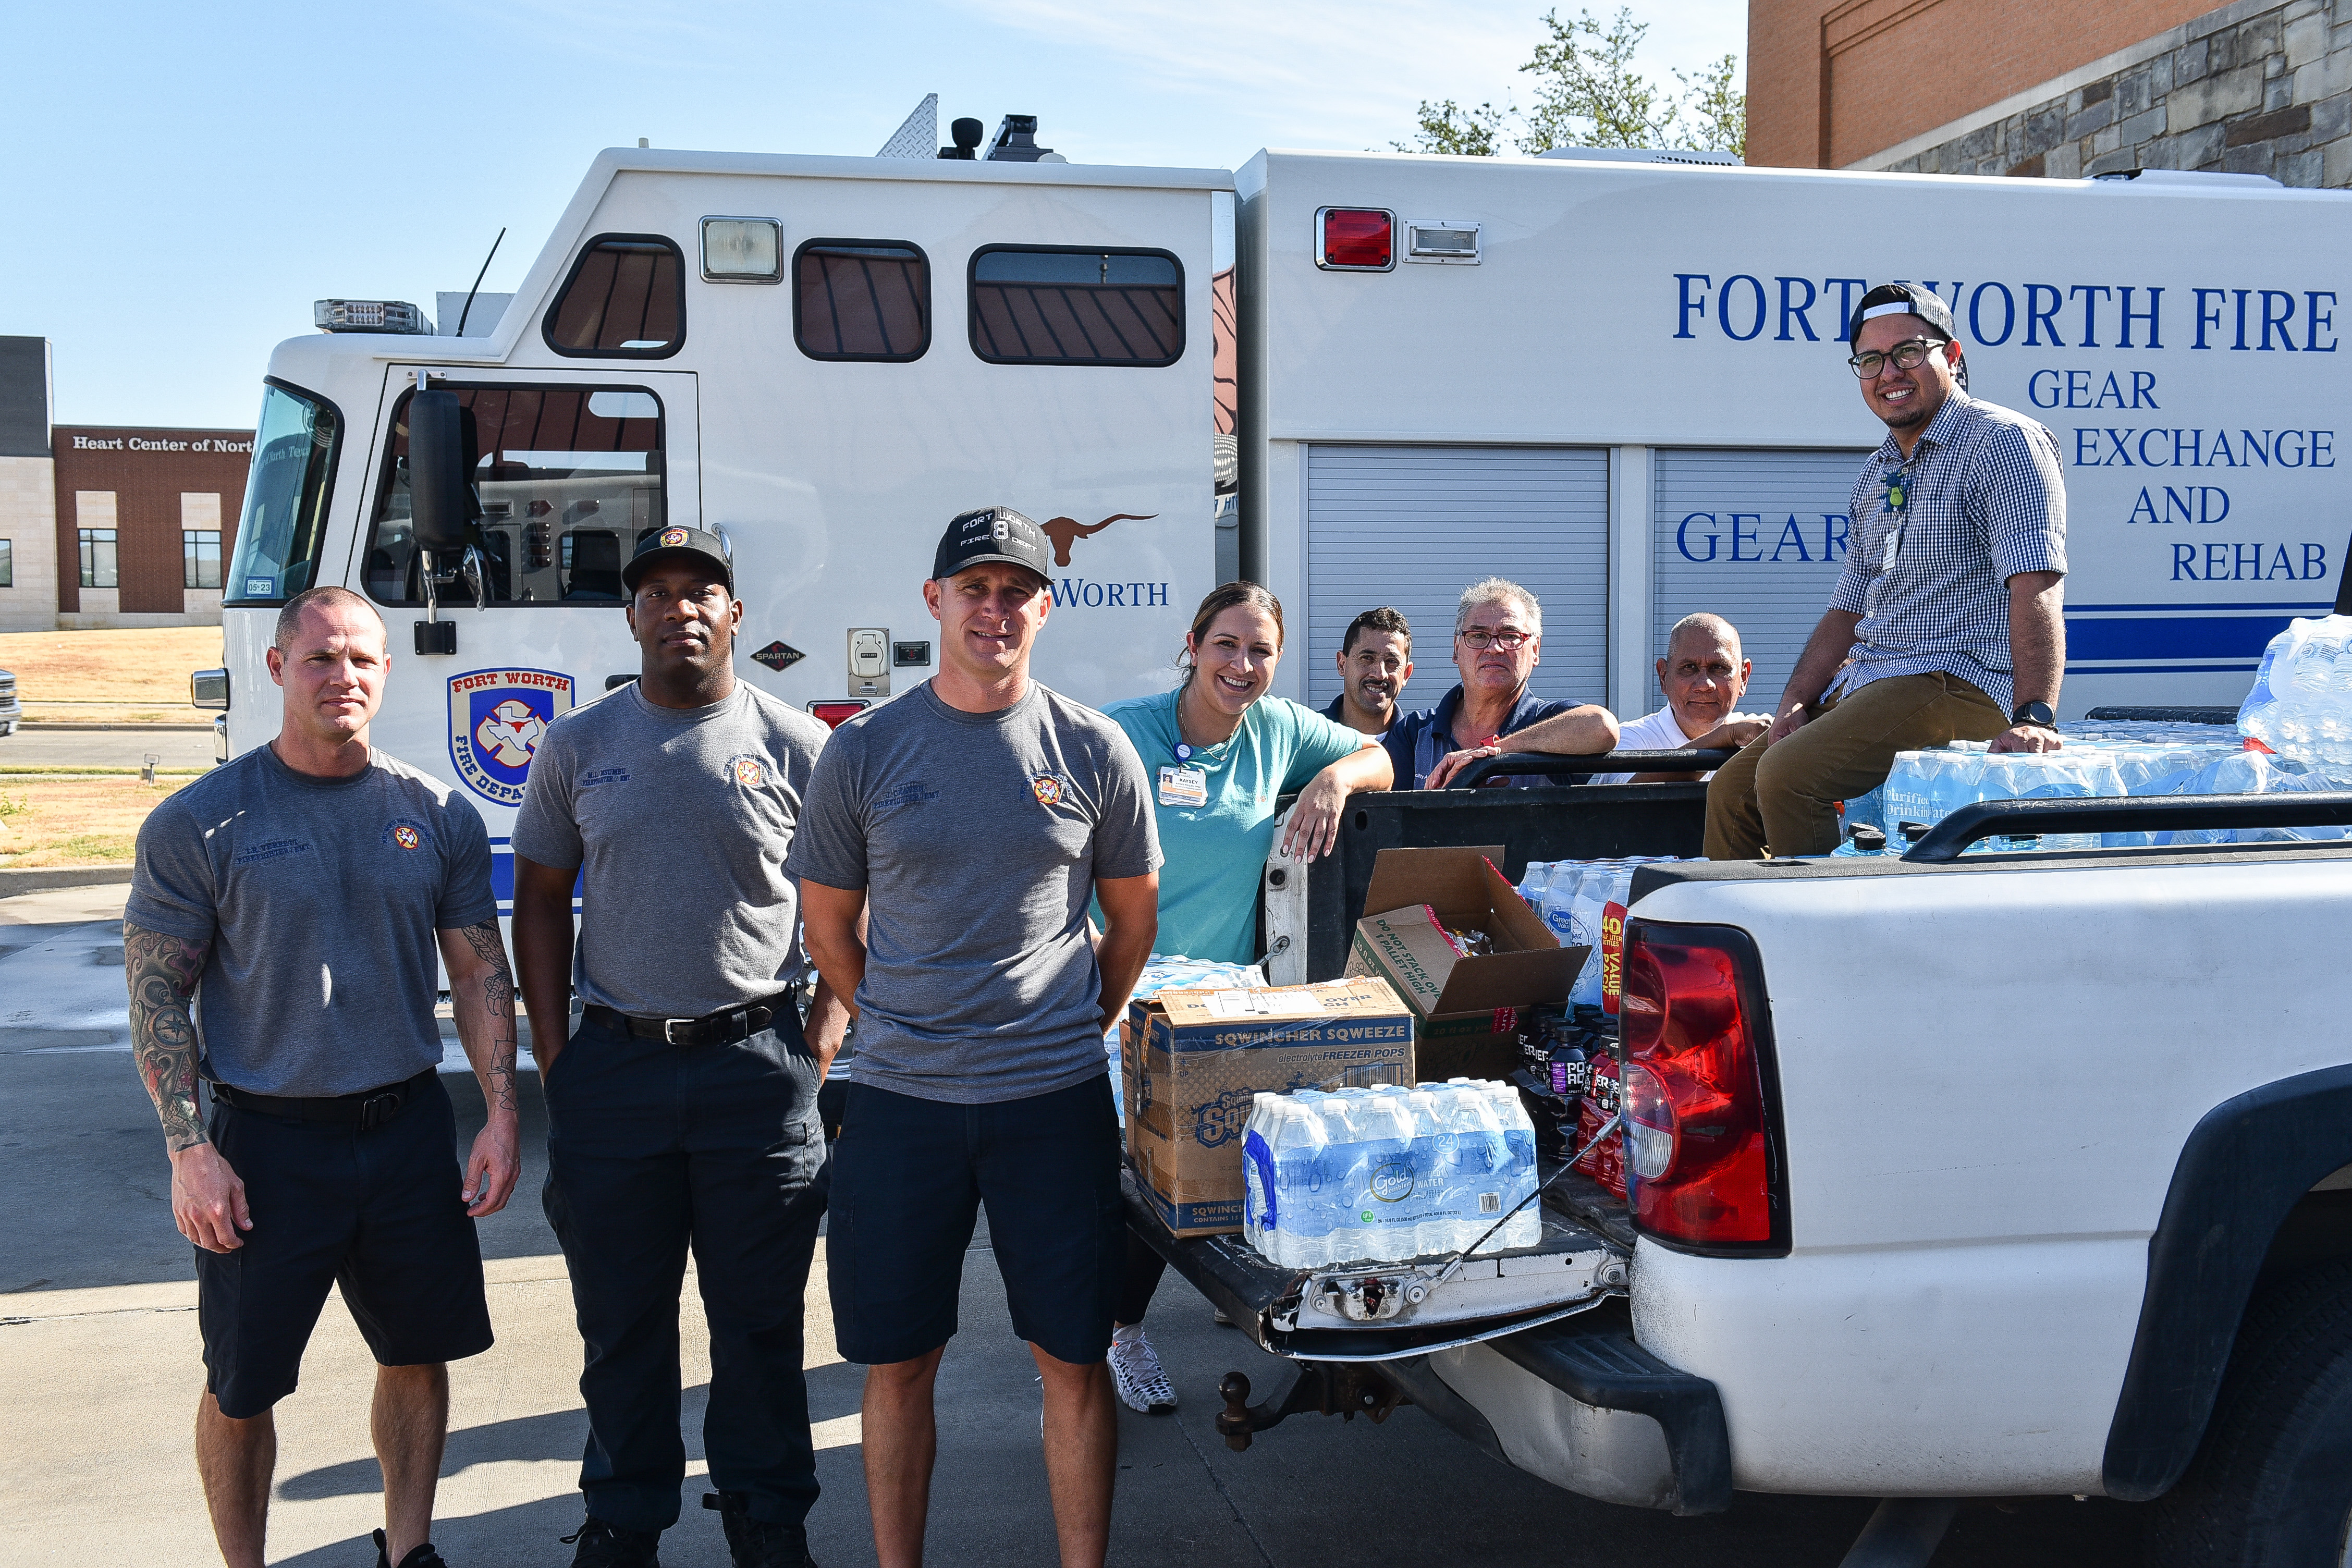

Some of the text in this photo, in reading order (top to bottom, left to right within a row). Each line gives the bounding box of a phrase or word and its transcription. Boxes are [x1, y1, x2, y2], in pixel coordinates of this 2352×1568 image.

[1672, 274, 2338, 352] FORT ORTH FIRE
[2028, 369, 2161, 409] GEAR
[73, 436, 254, 452] Heart Center of Nort
[2072, 428, 2336, 468] EXCHANGE
[2127, 486, 2231, 524] AND
[962, 511, 1036, 538] FORT WORTH
[993, 520, 1009, 540] 8
[1676, 511, 1850, 562] GEAR
[960, 534, 1037, 552] FIRE DEPT
[2170, 543, 2328, 581] REHAB
[1050, 578, 1169, 608] WORTH
[756, 652, 800, 660] SPARTAN
[452, 672, 569, 693] FORT WORTH
[455, 735, 479, 776] FIRE
[475, 775, 526, 800] DEPA
[1930, 807, 1952, 818] ate
[1552, 914, 1571, 925] Great
[1602, 915, 1621, 935] 40
[1356, 939, 1363, 951] 20
[1368, 958, 1375, 970] oz
[1376, 918, 1441, 1000] DO NOT STACK OVE
[1379, 940, 1408, 970] PALLET
[1403, 969, 1427, 995] HIGH
[1609, 952, 1620, 996] VALUE
[1215, 1025, 1405, 1046] SQWINCHER SQWEEZE
[1373, 1047, 1405, 1059] POPS
[1438, 1134, 1454, 1147] 24
[1374, 1167, 1409, 1196] Gold
[1416, 1170, 1441, 1178] PURIFIED
[1417, 1178, 1444, 1189] WATER
[1388, 1181, 1412, 1194] emblem
